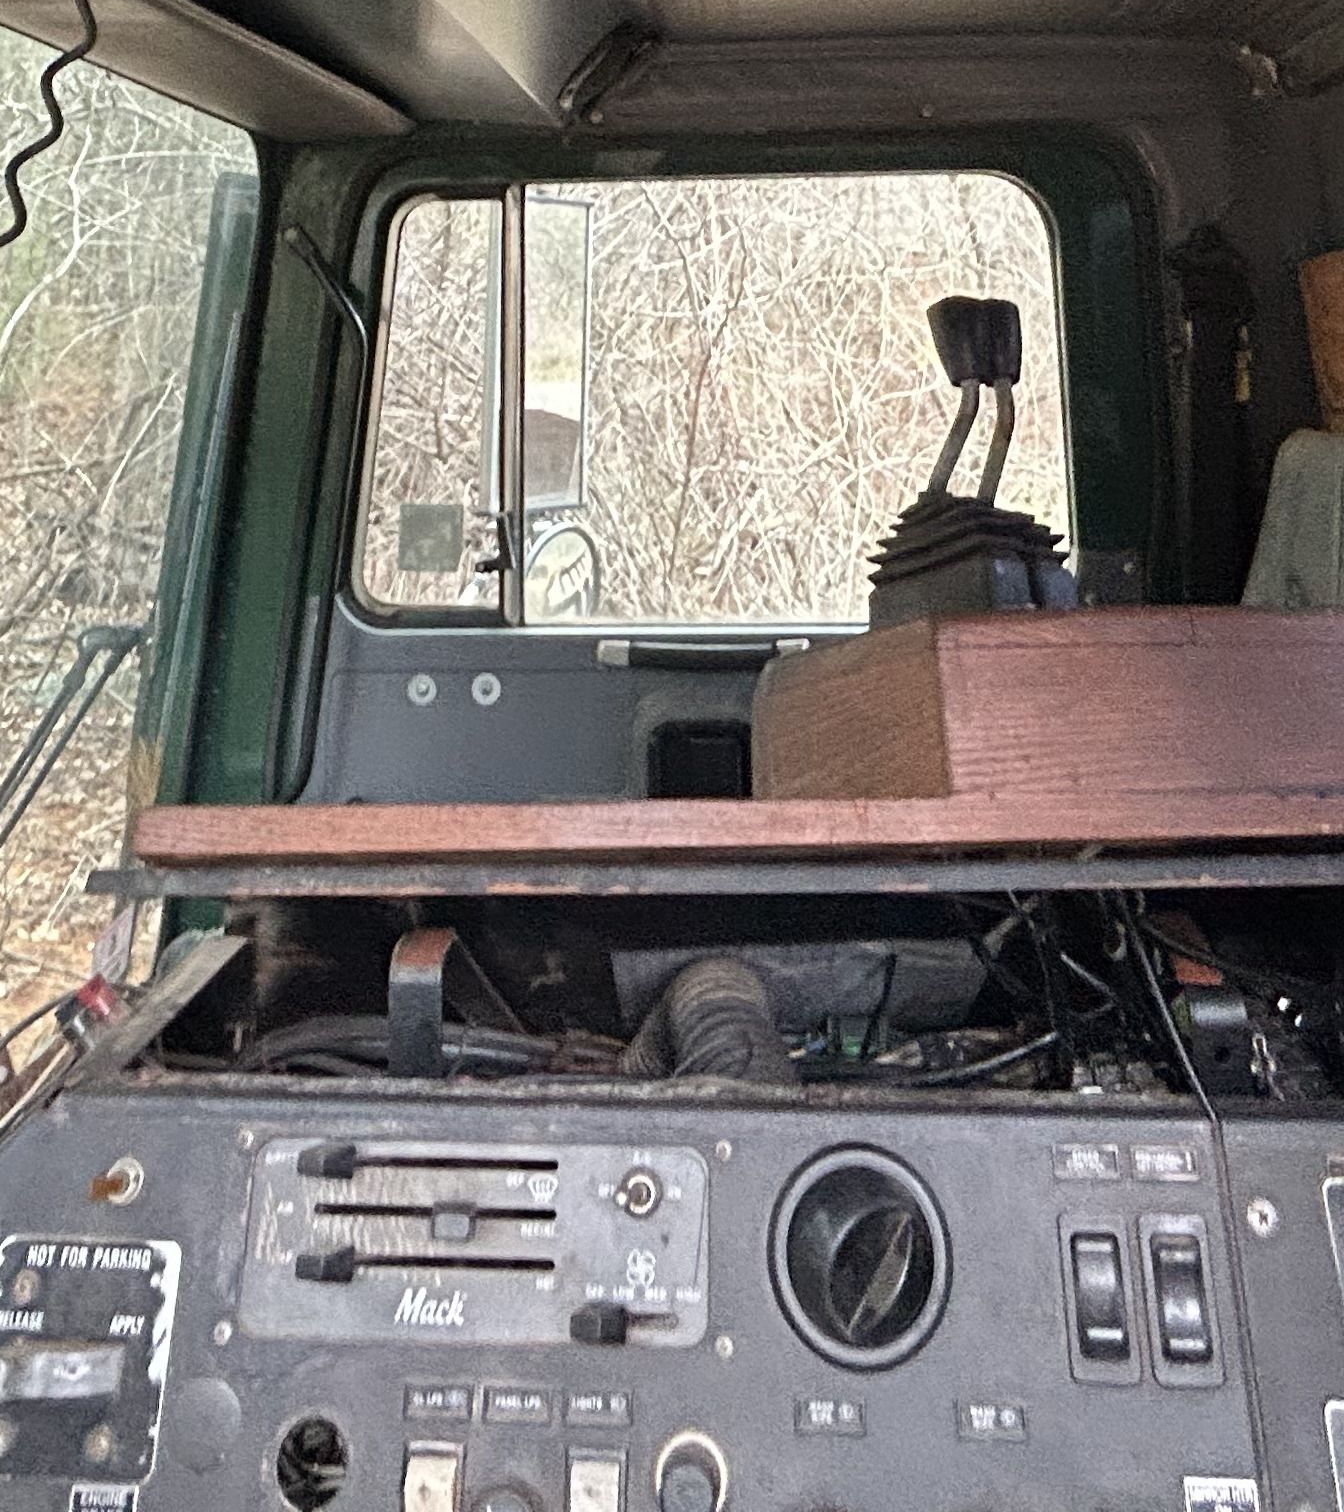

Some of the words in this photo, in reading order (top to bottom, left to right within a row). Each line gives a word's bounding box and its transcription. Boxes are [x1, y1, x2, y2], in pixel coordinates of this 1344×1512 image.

[27, 1244, 56, 1267] NOT
[60, 1245, 90, 1268] FOR
[91, 1246, 152, 1271] PARKING
[394, 1288, 464, 1327] Mack
[109, 1314, 145, 1336] APPLY
